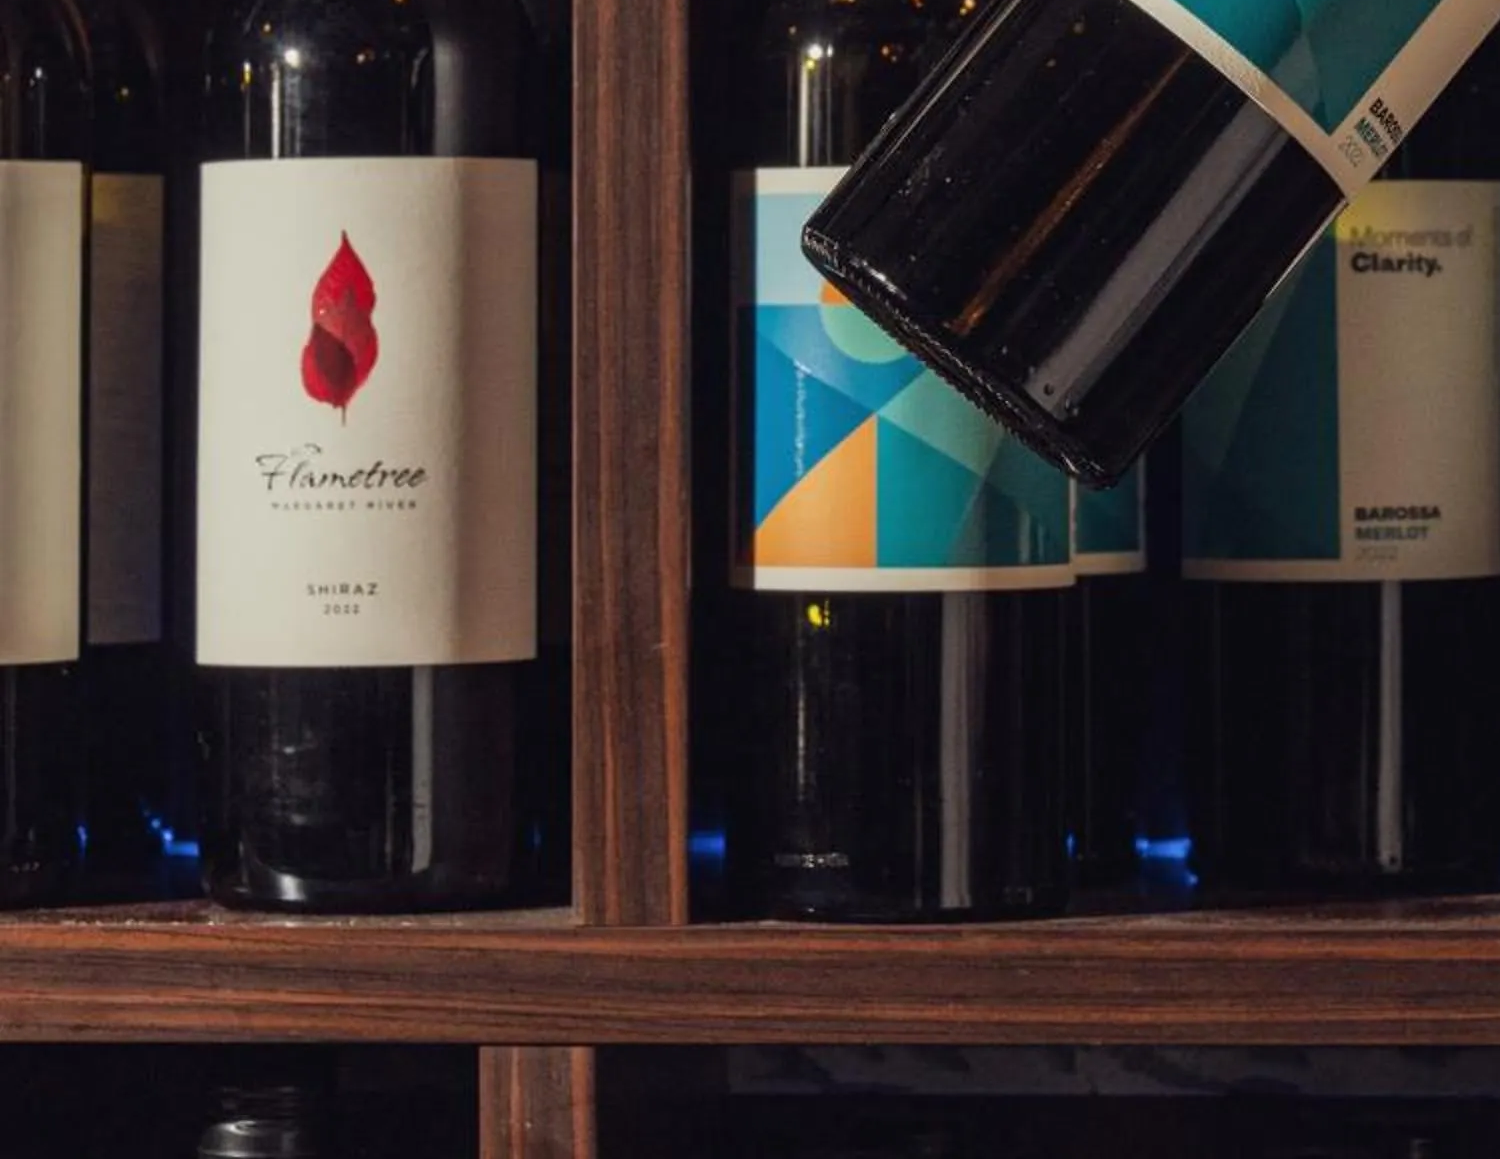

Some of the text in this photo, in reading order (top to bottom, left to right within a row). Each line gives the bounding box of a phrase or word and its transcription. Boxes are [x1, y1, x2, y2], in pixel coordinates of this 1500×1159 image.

[1350, 251, 1443, 278] Clarity.
[255, 442, 427, 491] Flametree
[366, 500, 417, 511] RIVER
[1354, 505, 1441, 521] BAROSSA
[1355, 526, 1429, 541] MERLOT
[307, 582, 379, 596] SHIRAZ
